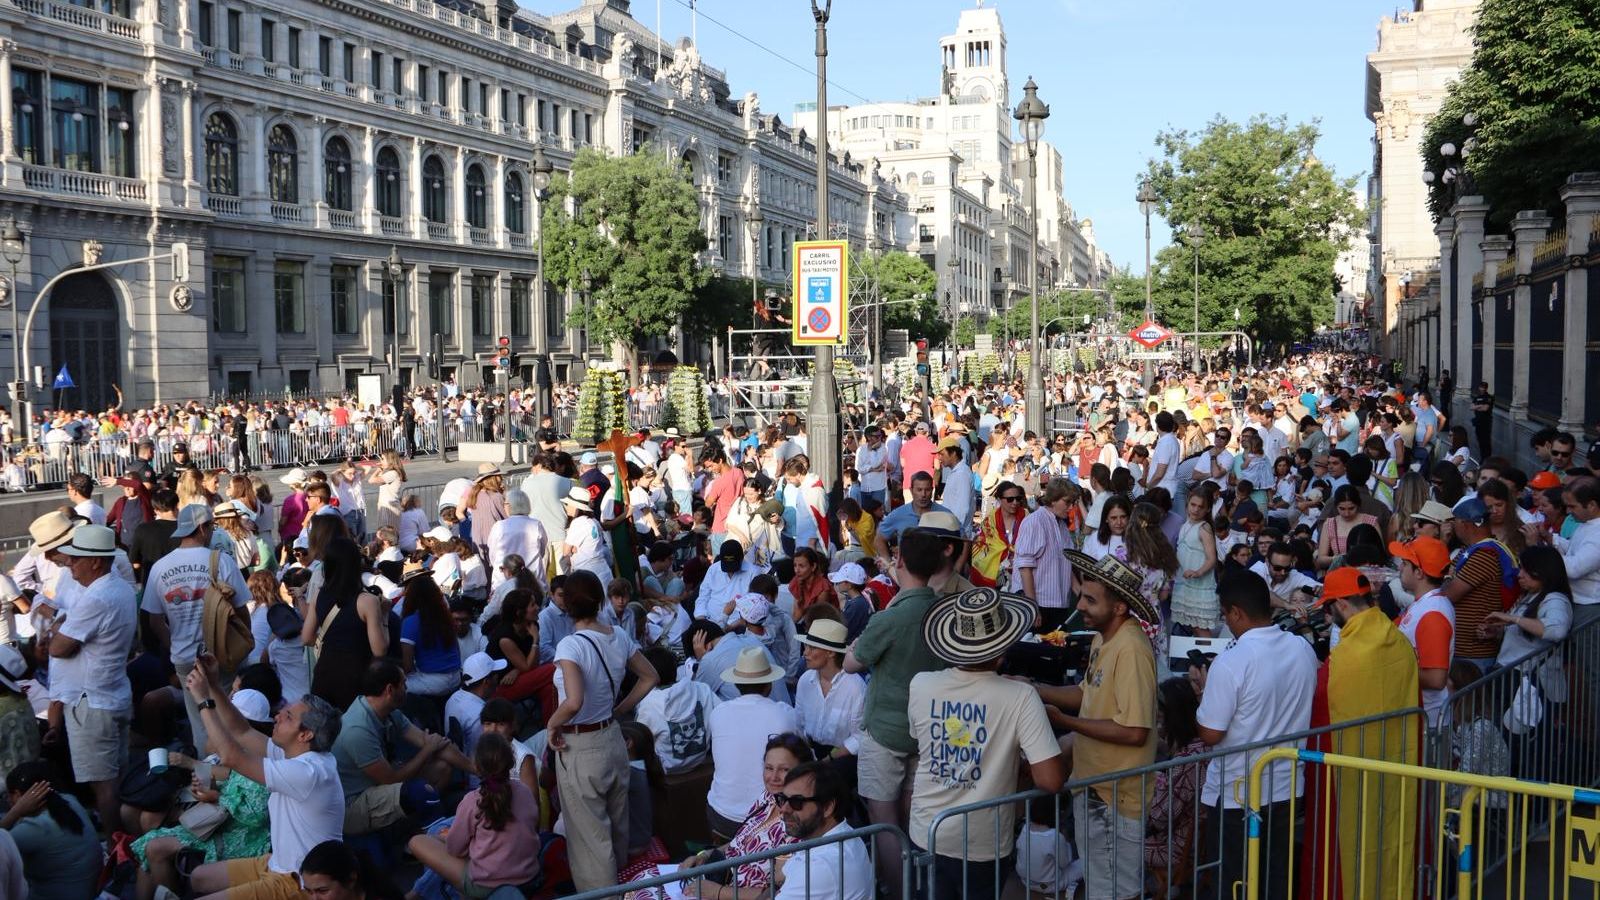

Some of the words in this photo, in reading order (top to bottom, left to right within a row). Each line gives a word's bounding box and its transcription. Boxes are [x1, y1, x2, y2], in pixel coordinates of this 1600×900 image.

[930, 699, 987, 724] LIMON
[930, 741, 982, 765] LIMON
[929, 760, 982, 782] CELLO
